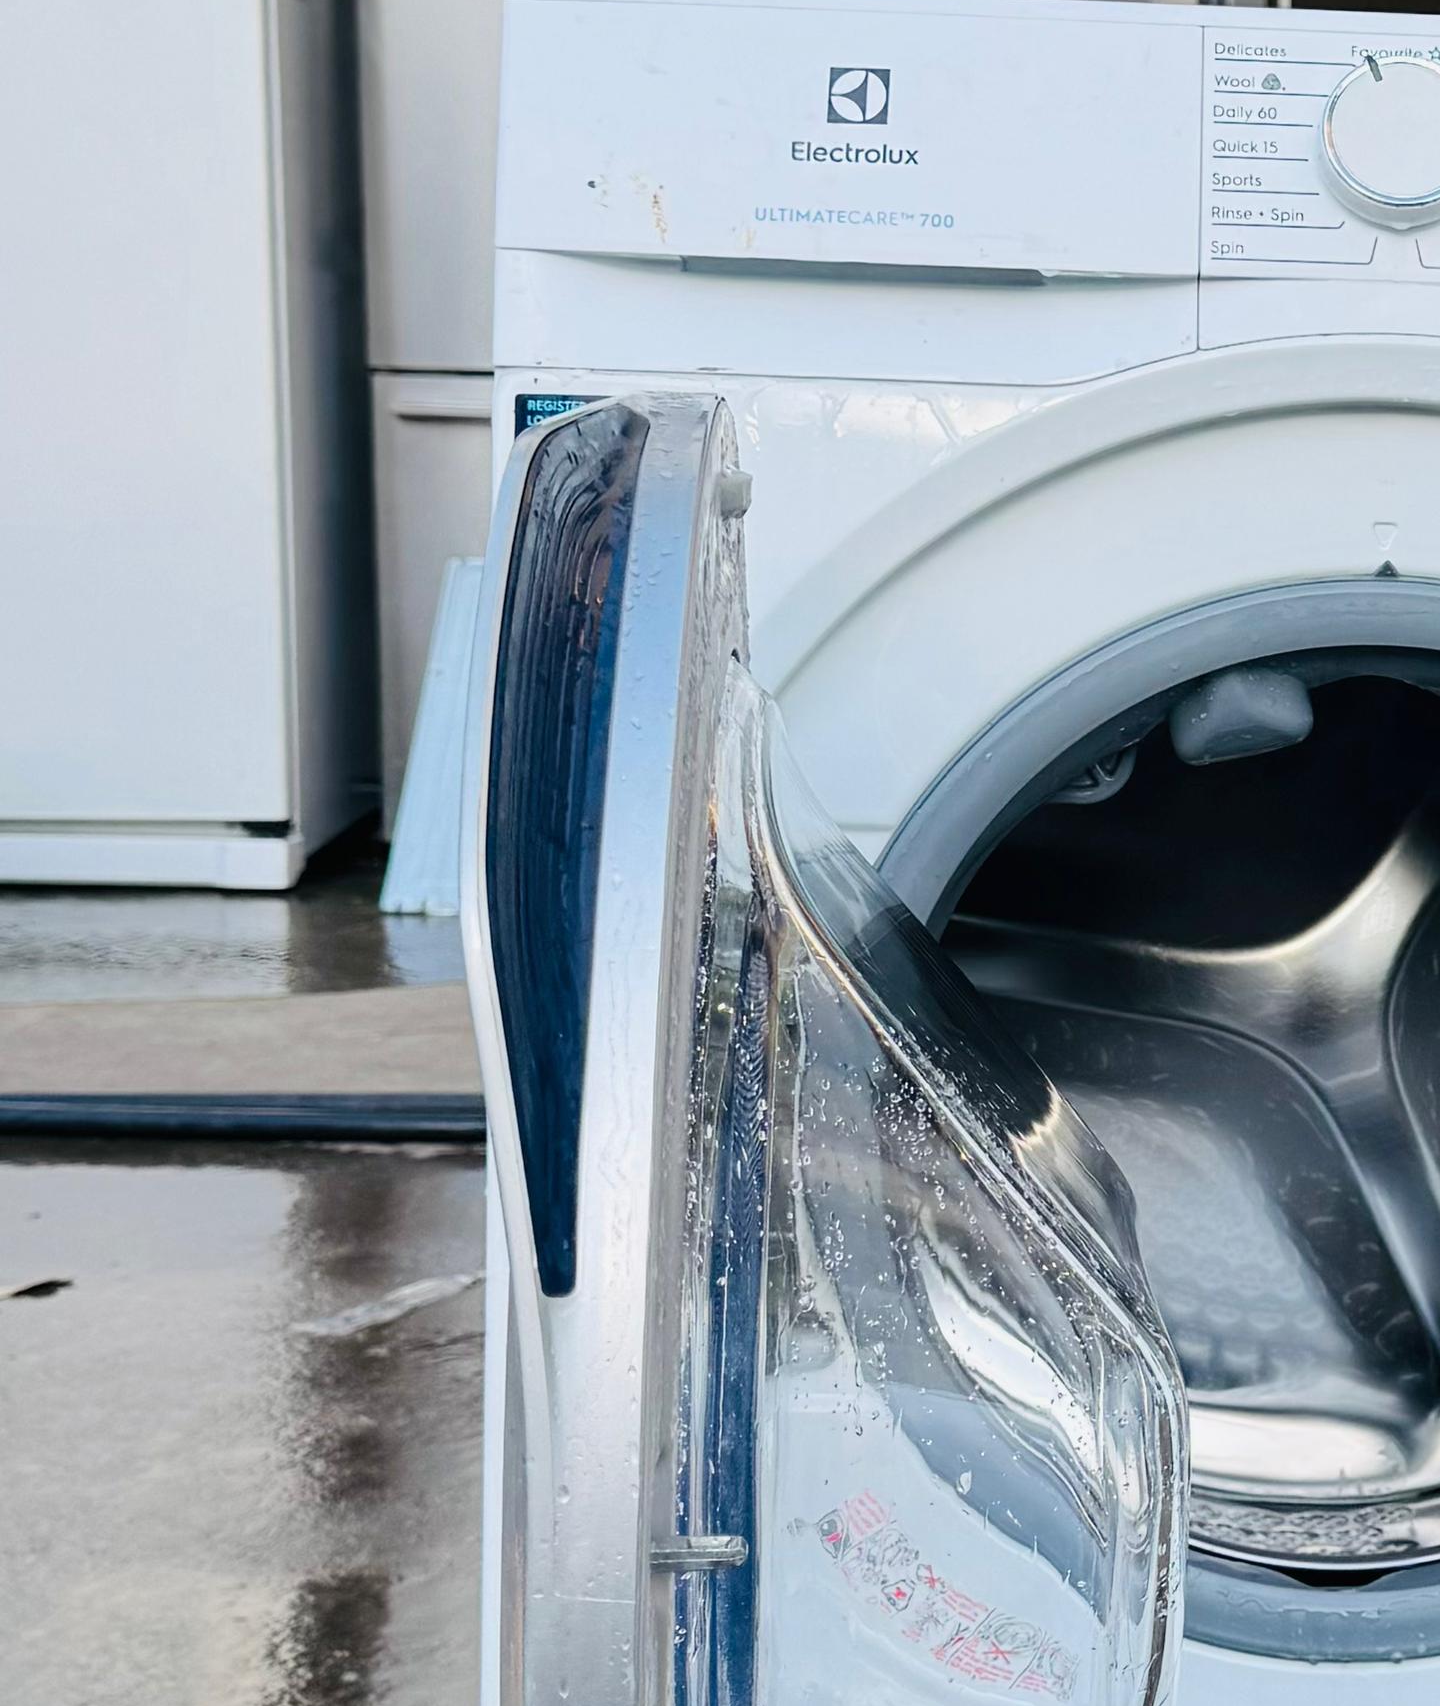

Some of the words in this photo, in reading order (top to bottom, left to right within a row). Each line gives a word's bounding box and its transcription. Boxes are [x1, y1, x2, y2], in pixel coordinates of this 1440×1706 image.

[1213, 42, 1287, 58] Delicates
[1214, 73, 1256, 89] Wool
[1213, 104, 1254, 122] Daily
[1258, 106, 1278, 121] 60
[790, 140, 920, 166] Electrolux
[1212, 138, 1260, 154] Quick
[1263, 140, 1279, 154] 15
[1211, 172, 1263, 189] Sports
[919, 212, 956, 230] 700
[1211, 206, 1254, 221] Rinse
[1270, 207, 1305, 224] Spin
[1210, 240, 1245, 258] Spin
